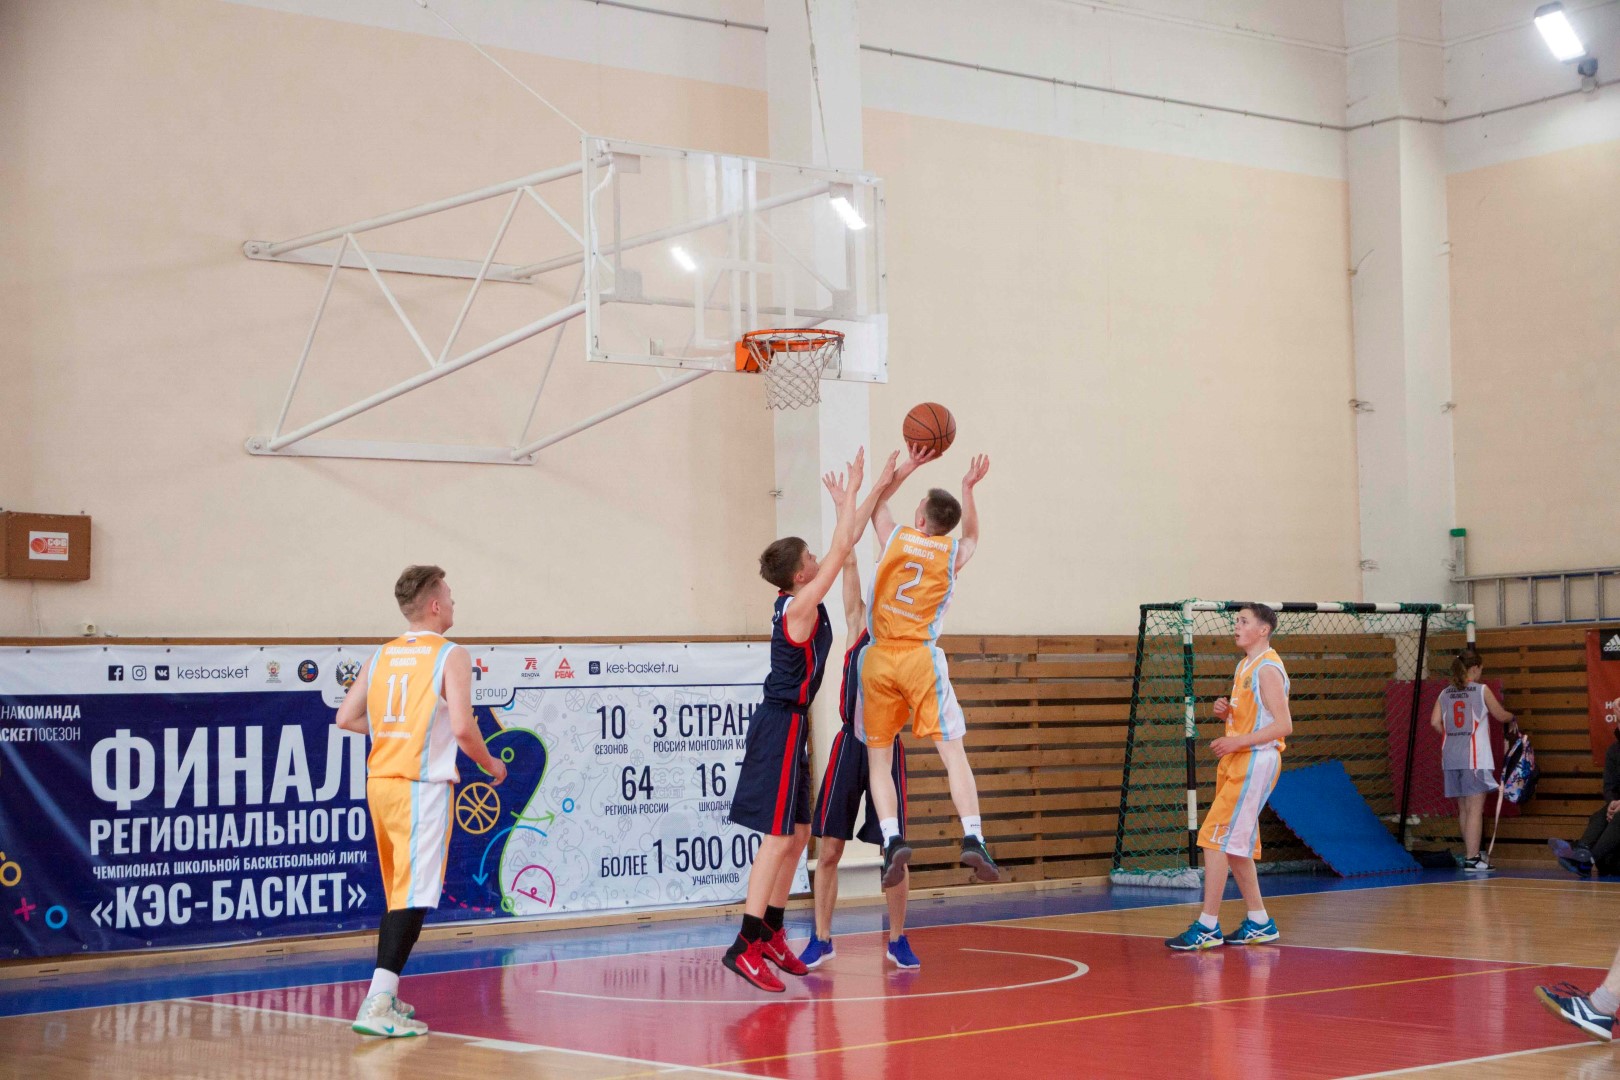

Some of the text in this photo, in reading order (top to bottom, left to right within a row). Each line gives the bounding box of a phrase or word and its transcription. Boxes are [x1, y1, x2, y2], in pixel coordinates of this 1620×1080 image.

[895, 561, 924, 605] 2
[177, 665, 250, 680] kesbasket
[554, 670, 575, 679] PEAK
[606, 661, 679, 674] kes-basket.ru
[383, 673, 409, 723] 11
[475, 687, 508, 701] group
[597, 705, 626, 740] 10
[653, 703, 759, 738] 3 СТРАН
[1453, 700, 1465, 729] 6
[594, 744, 628, 755] СЕЗОНОВ
[653, 740, 686, 753] РОССИЯ
[688, 739, 733, 751] МОНГОЛИЯ
[90, 723, 366, 811] ФИНАЛ
[696, 762, 727, 798] 16
[621, 765, 654, 801] 64
[605, 803, 669, 816] РЕГИОНА РОССИИ
[90, 807, 367, 856] РЕГИОНАЛЬНОГО
[1209, 823, 1230, 846] 12
[92, 850, 367, 880] ЧЕМПИОНАТА ШКОЛЬНОЙ БАСКЕТБОЛЬНОЙ ЛИГИ
[601, 855, 648, 878] БОЛЕЕ
[675, 836, 723, 873] 500
[731, 833, 762, 869] 00
[692, 873, 740, 886] УЧАСТНИКОВ
[90, 872, 367, 929] «КЭС-БАСКЕТ»
